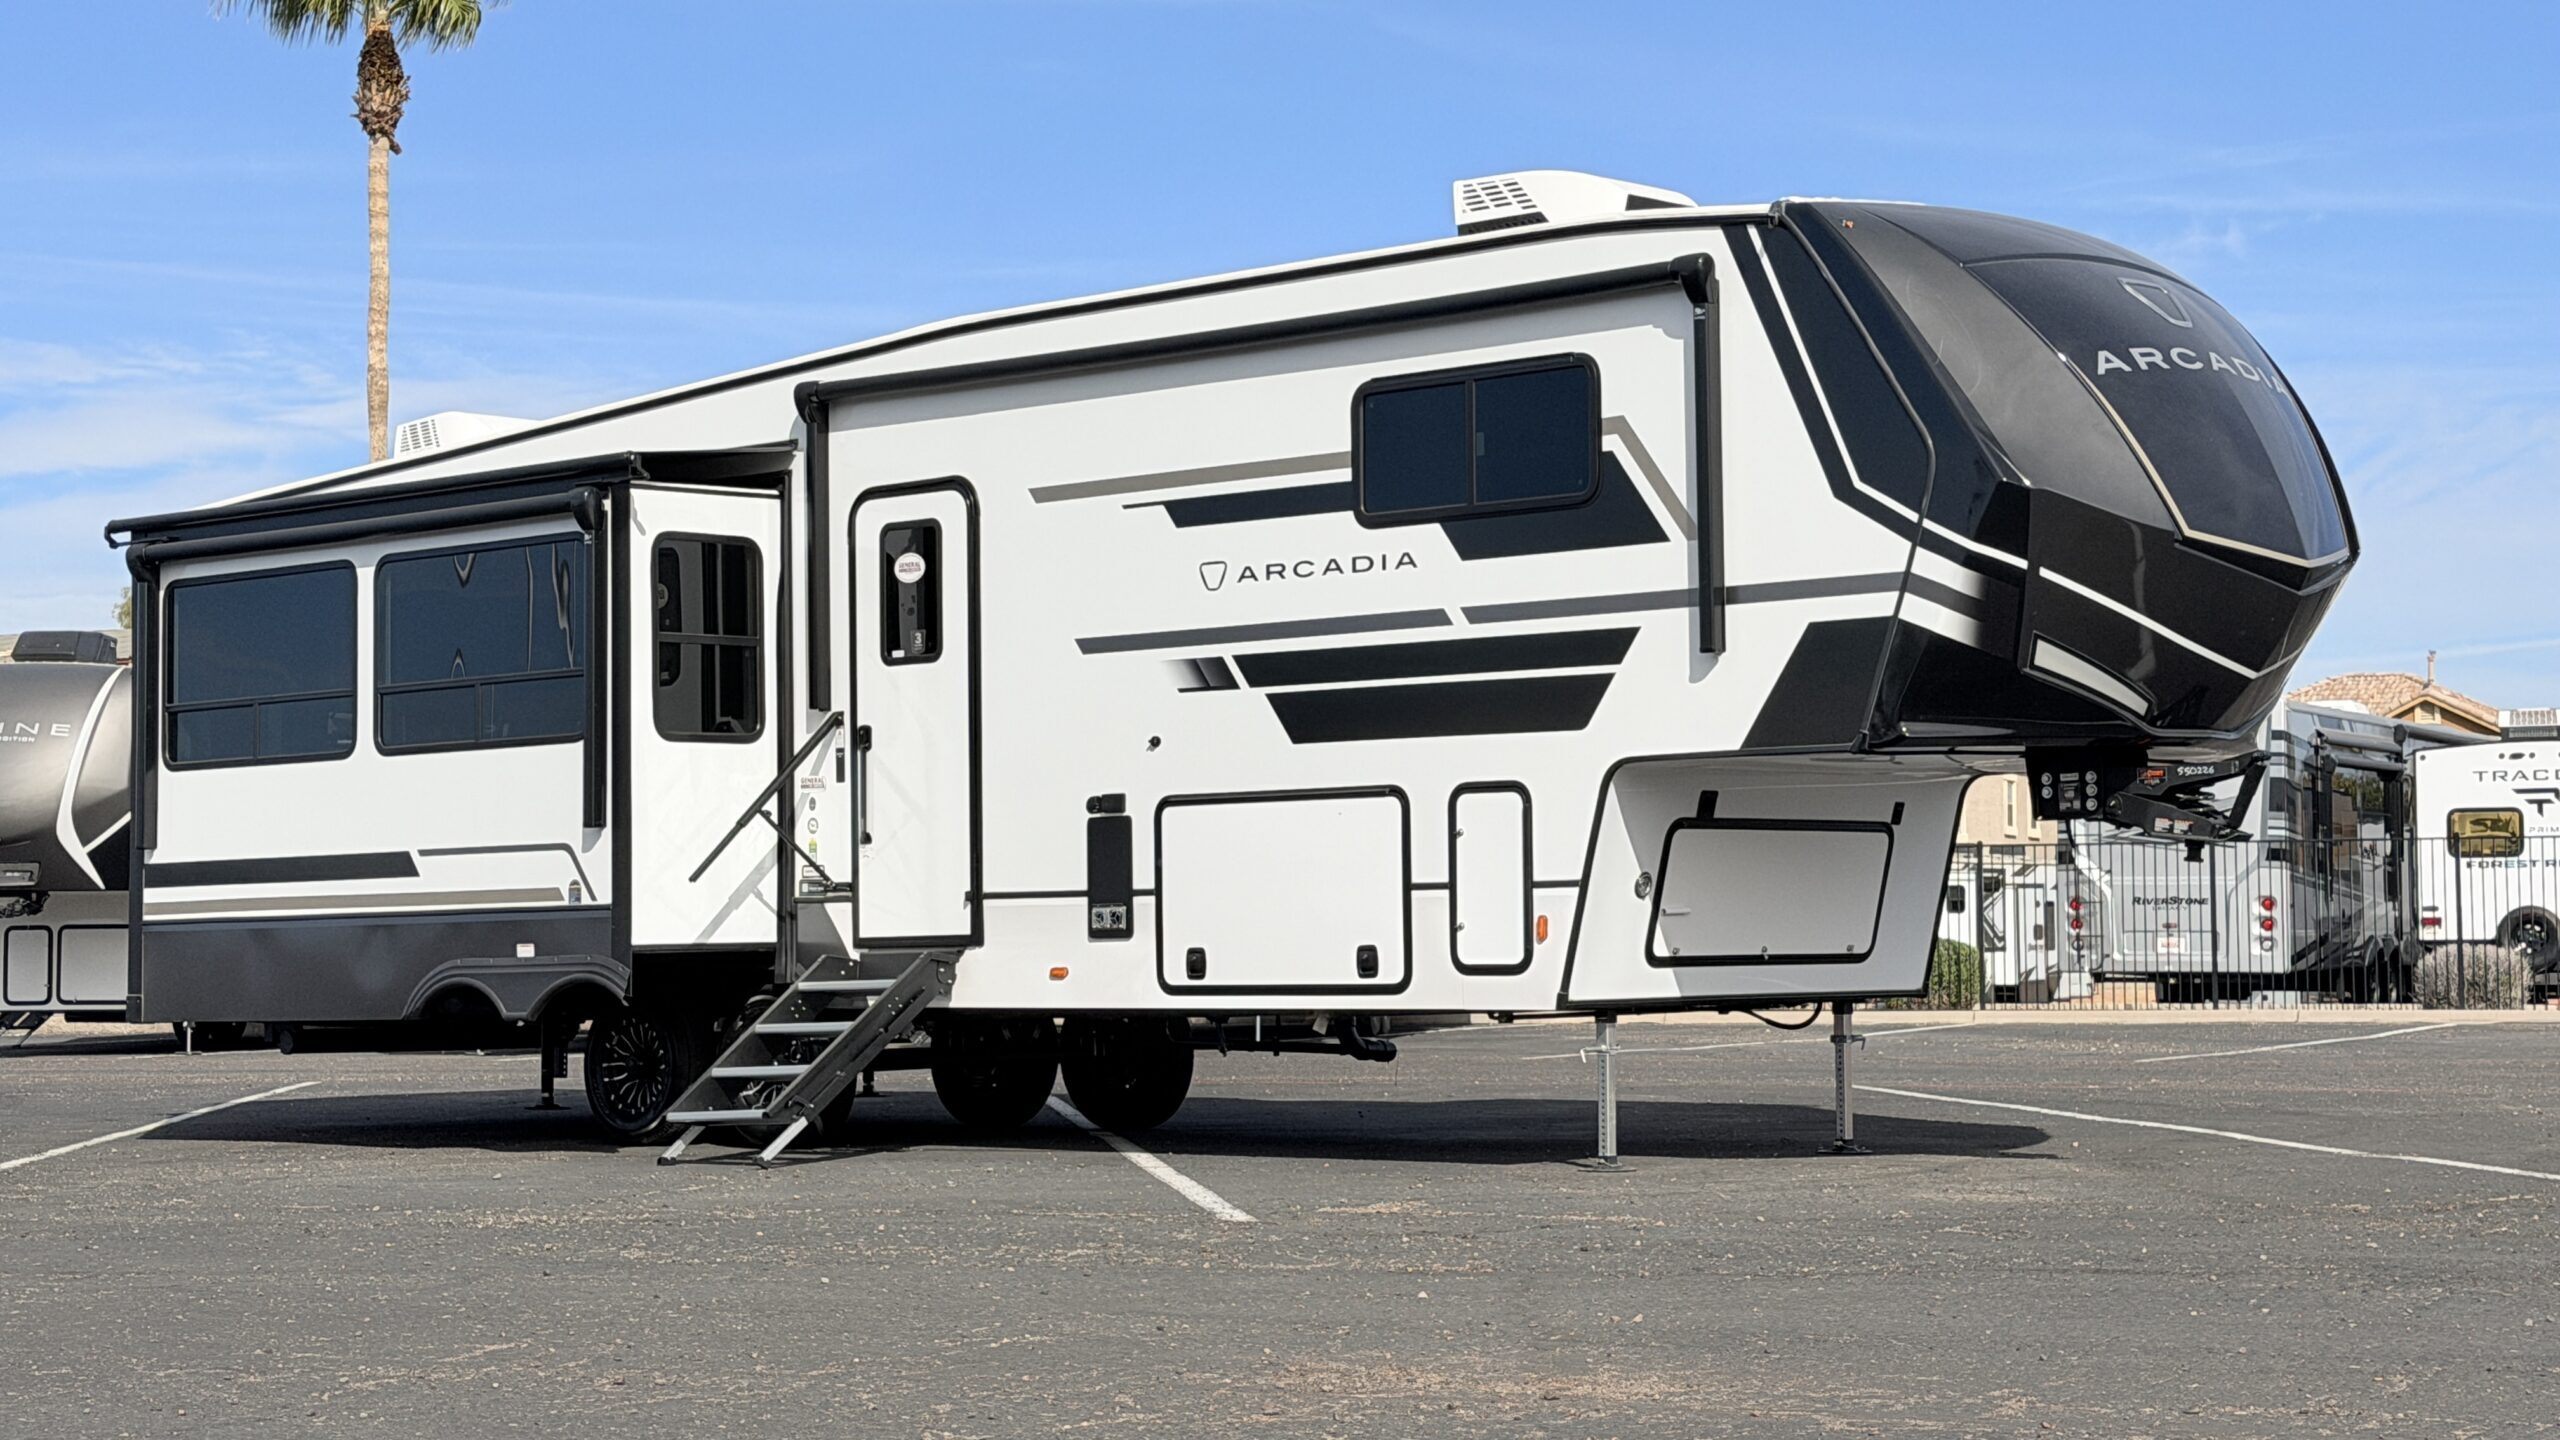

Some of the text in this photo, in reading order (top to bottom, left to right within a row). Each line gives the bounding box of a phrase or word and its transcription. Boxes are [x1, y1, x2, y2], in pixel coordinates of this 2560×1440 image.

[2097, 347, 2289, 397] ARCADIA
[1236, 551, 1418, 583] ARCADIA
[2177, 765, 2215, 776] 550226
[2466, 860, 2540, 868] FOREST
